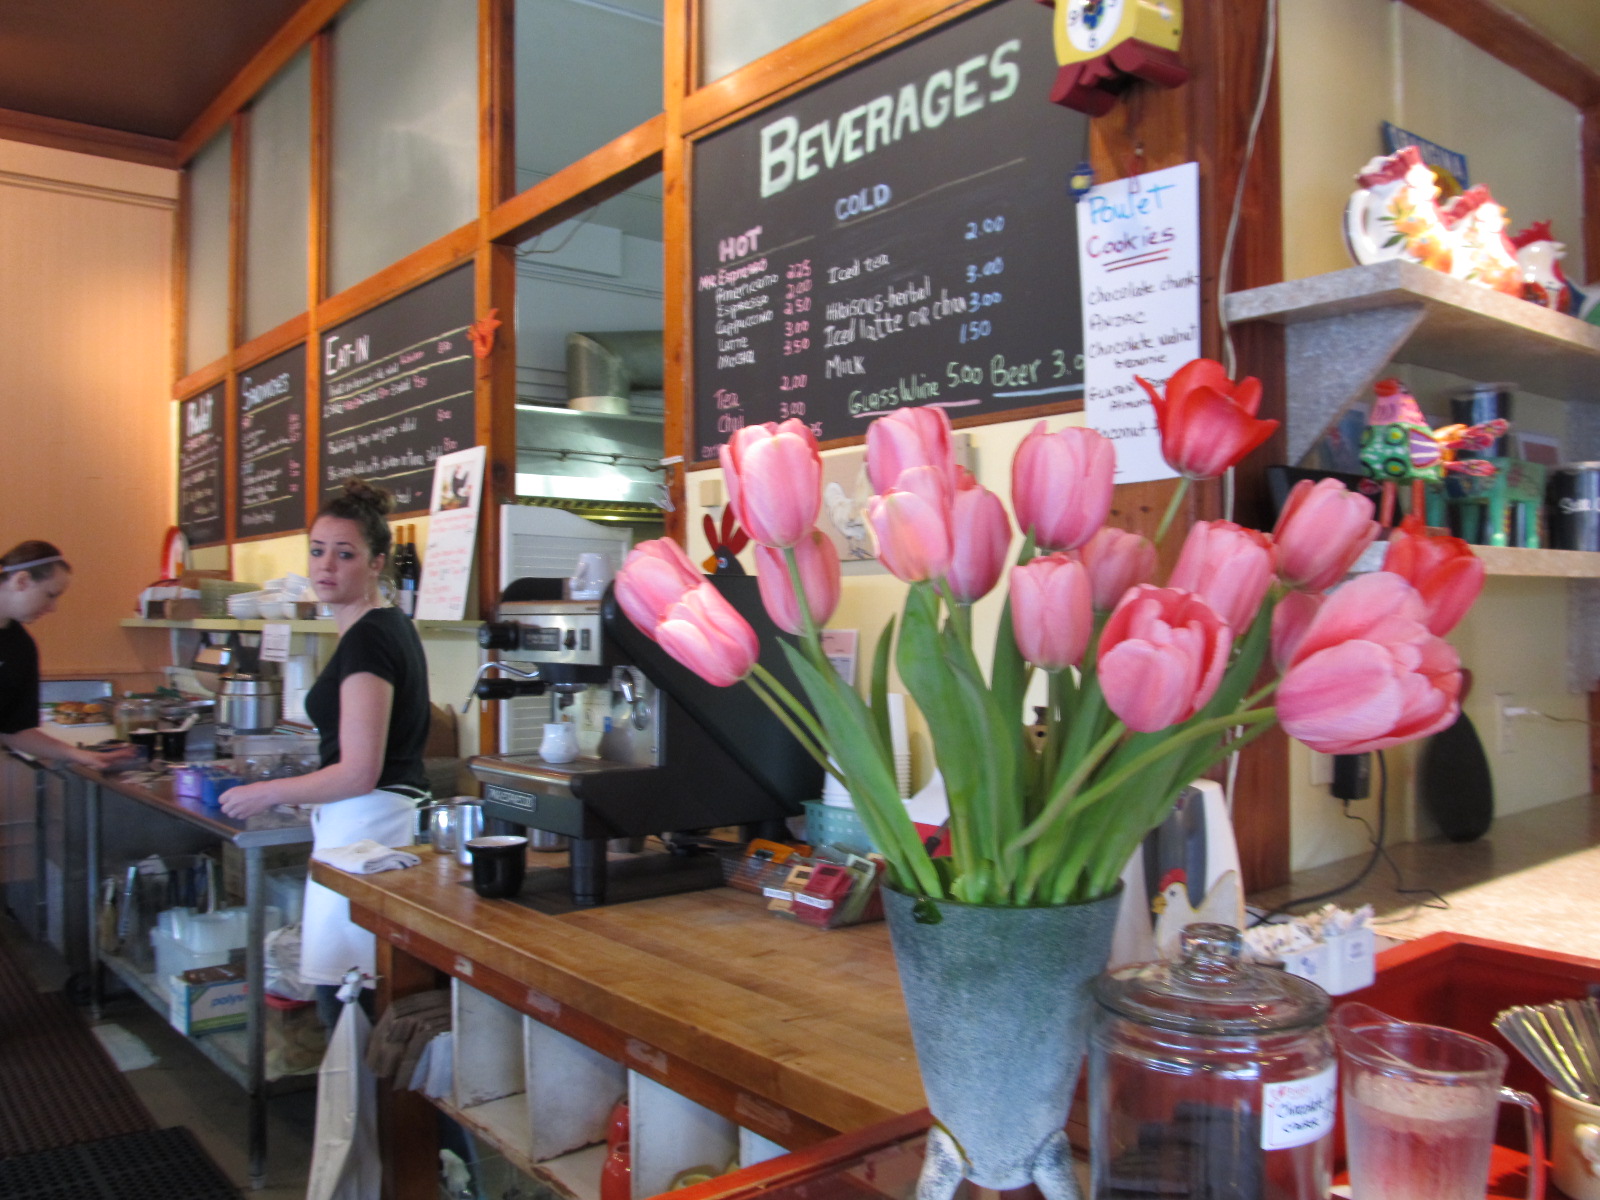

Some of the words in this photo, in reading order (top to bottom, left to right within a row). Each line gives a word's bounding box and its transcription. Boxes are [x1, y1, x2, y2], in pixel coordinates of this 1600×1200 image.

[760, 39, 1021, 197] BEVERAGES
[834, 184, 892, 221] COLD
[717, 225, 763, 262] HOT
[964, 215, 1006, 241] 2.00
[1086, 226, 1176, 259] Cookies
[989, 354, 1042, 387] Beer
